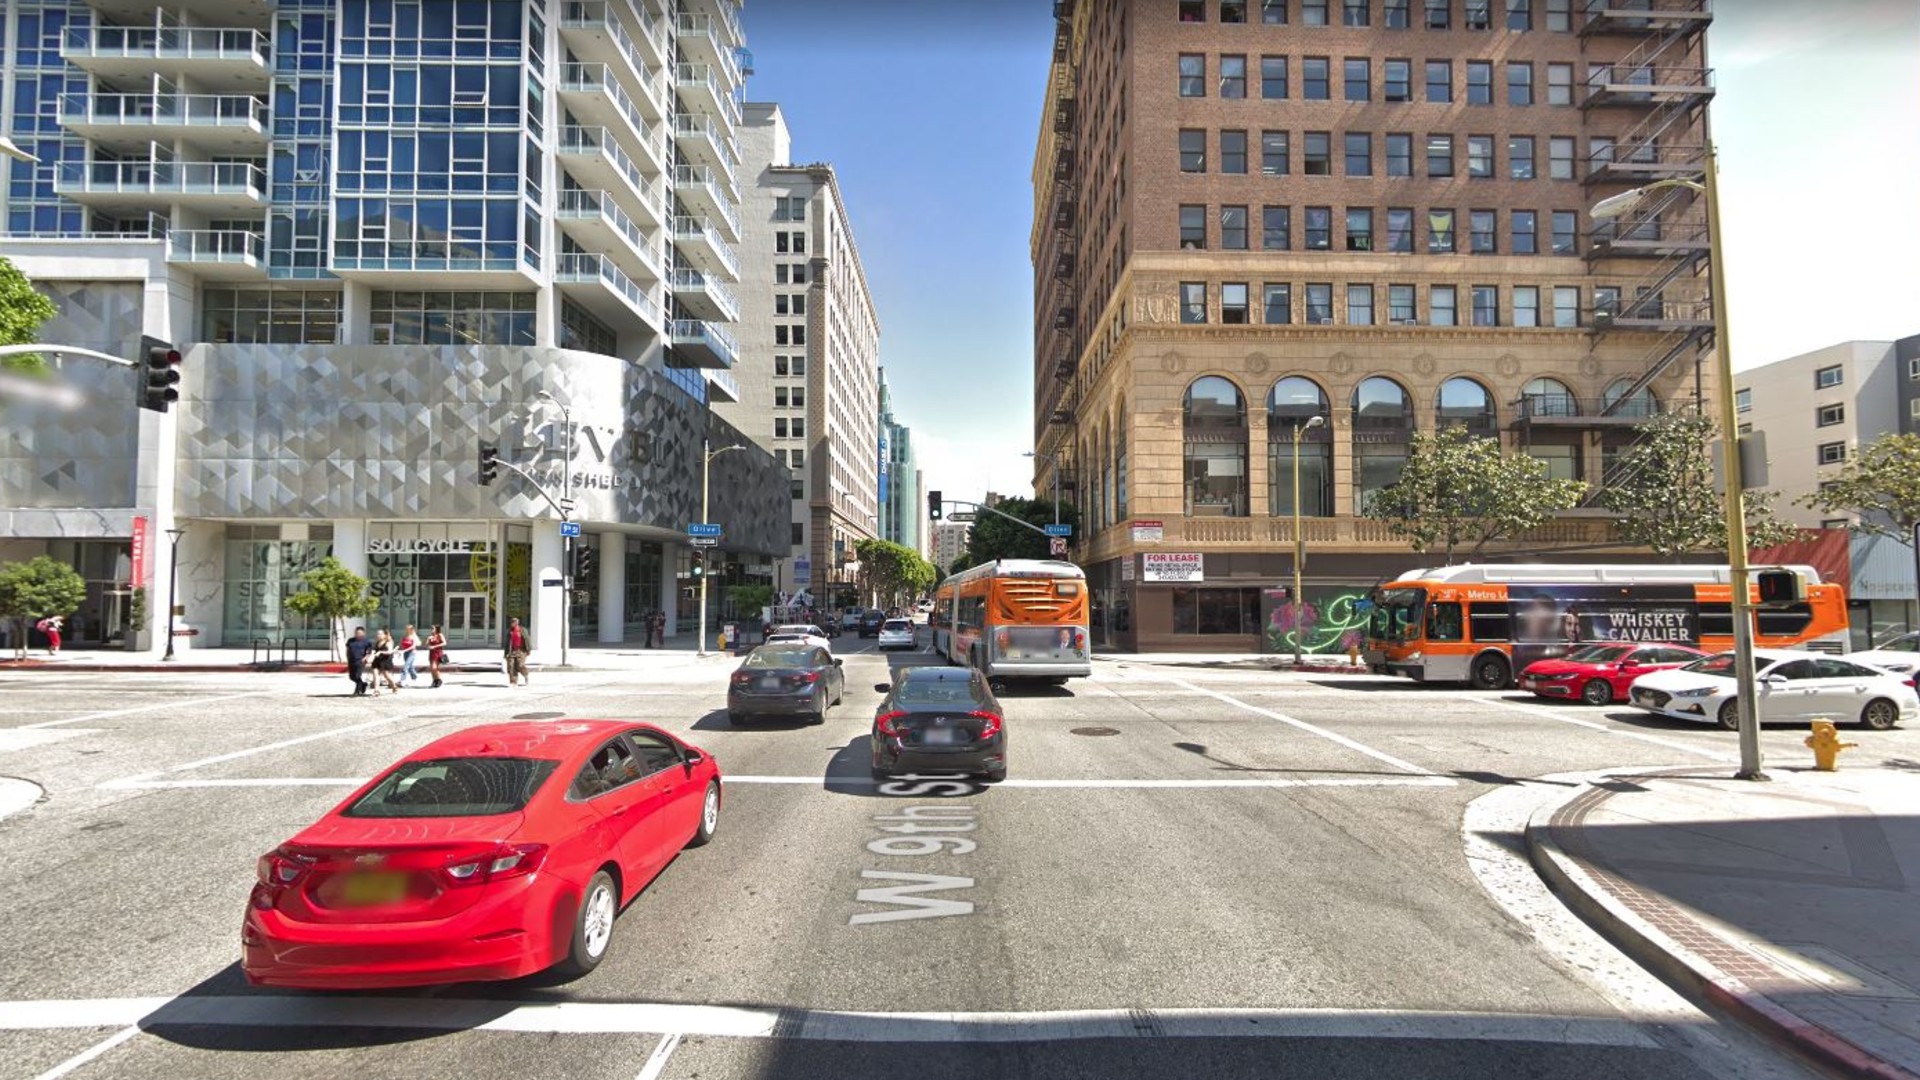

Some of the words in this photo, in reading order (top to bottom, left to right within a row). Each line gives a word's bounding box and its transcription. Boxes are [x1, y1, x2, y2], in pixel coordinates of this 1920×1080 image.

[369, 539, 471, 552] SOULCYCLE
[1147, 554, 1166, 562] FOR
[1169, 554, 1199, 562] LEASE
[1468, 590, 1496, 599] Metro
[1609, 613, 1686, 627] WHISKEY
[1609, 627, 1689, 641] CAVALIER
